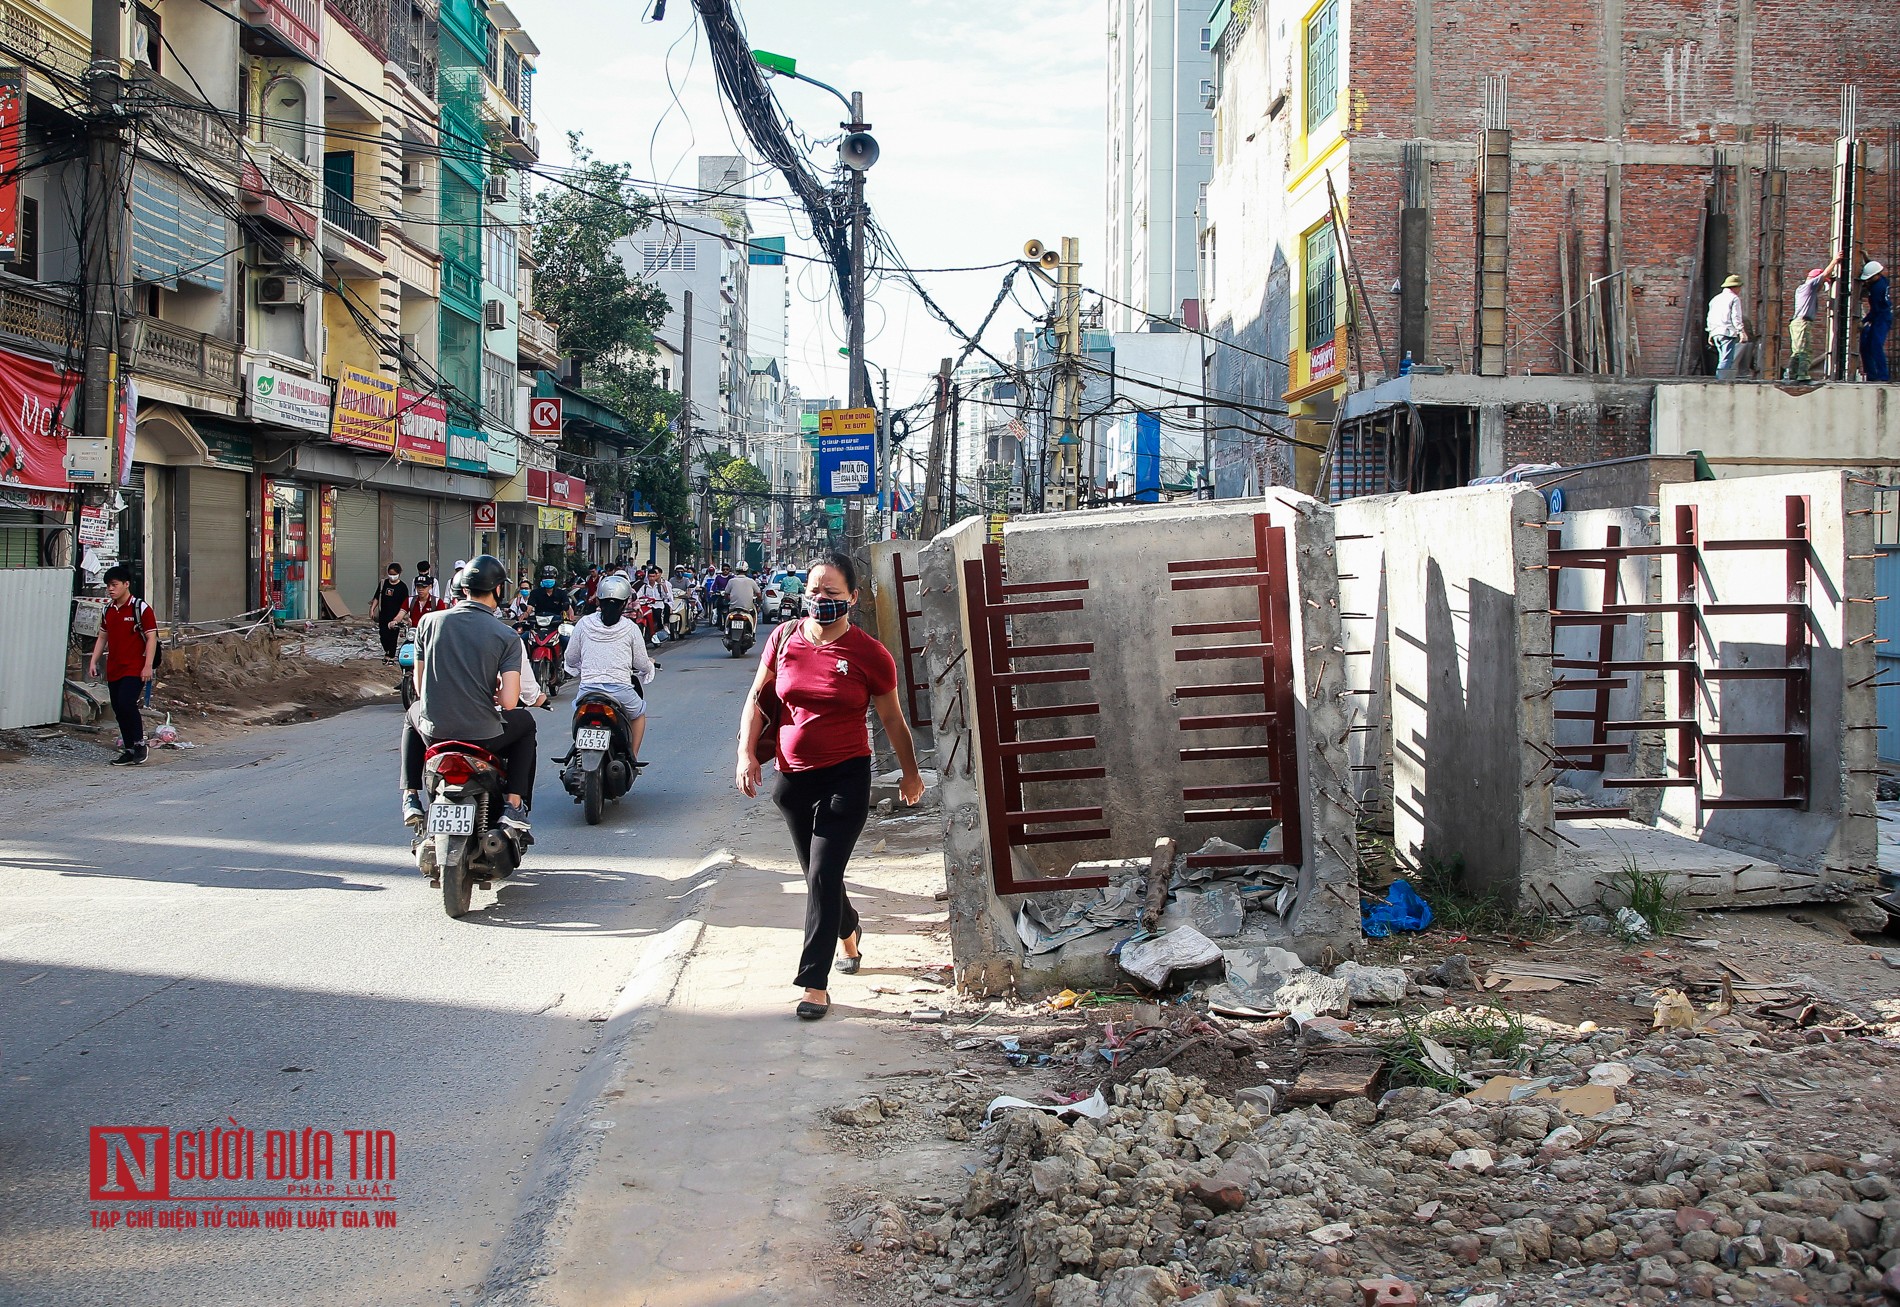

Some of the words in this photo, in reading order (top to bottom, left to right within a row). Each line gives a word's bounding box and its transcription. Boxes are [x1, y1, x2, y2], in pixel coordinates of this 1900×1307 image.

[582, 730, 606, 739] 29-E2
[578, 739, 606, 749] 045.34
[436, 806, 467, 819] 35-B1
[432, 820, 470, 833] 195.35
